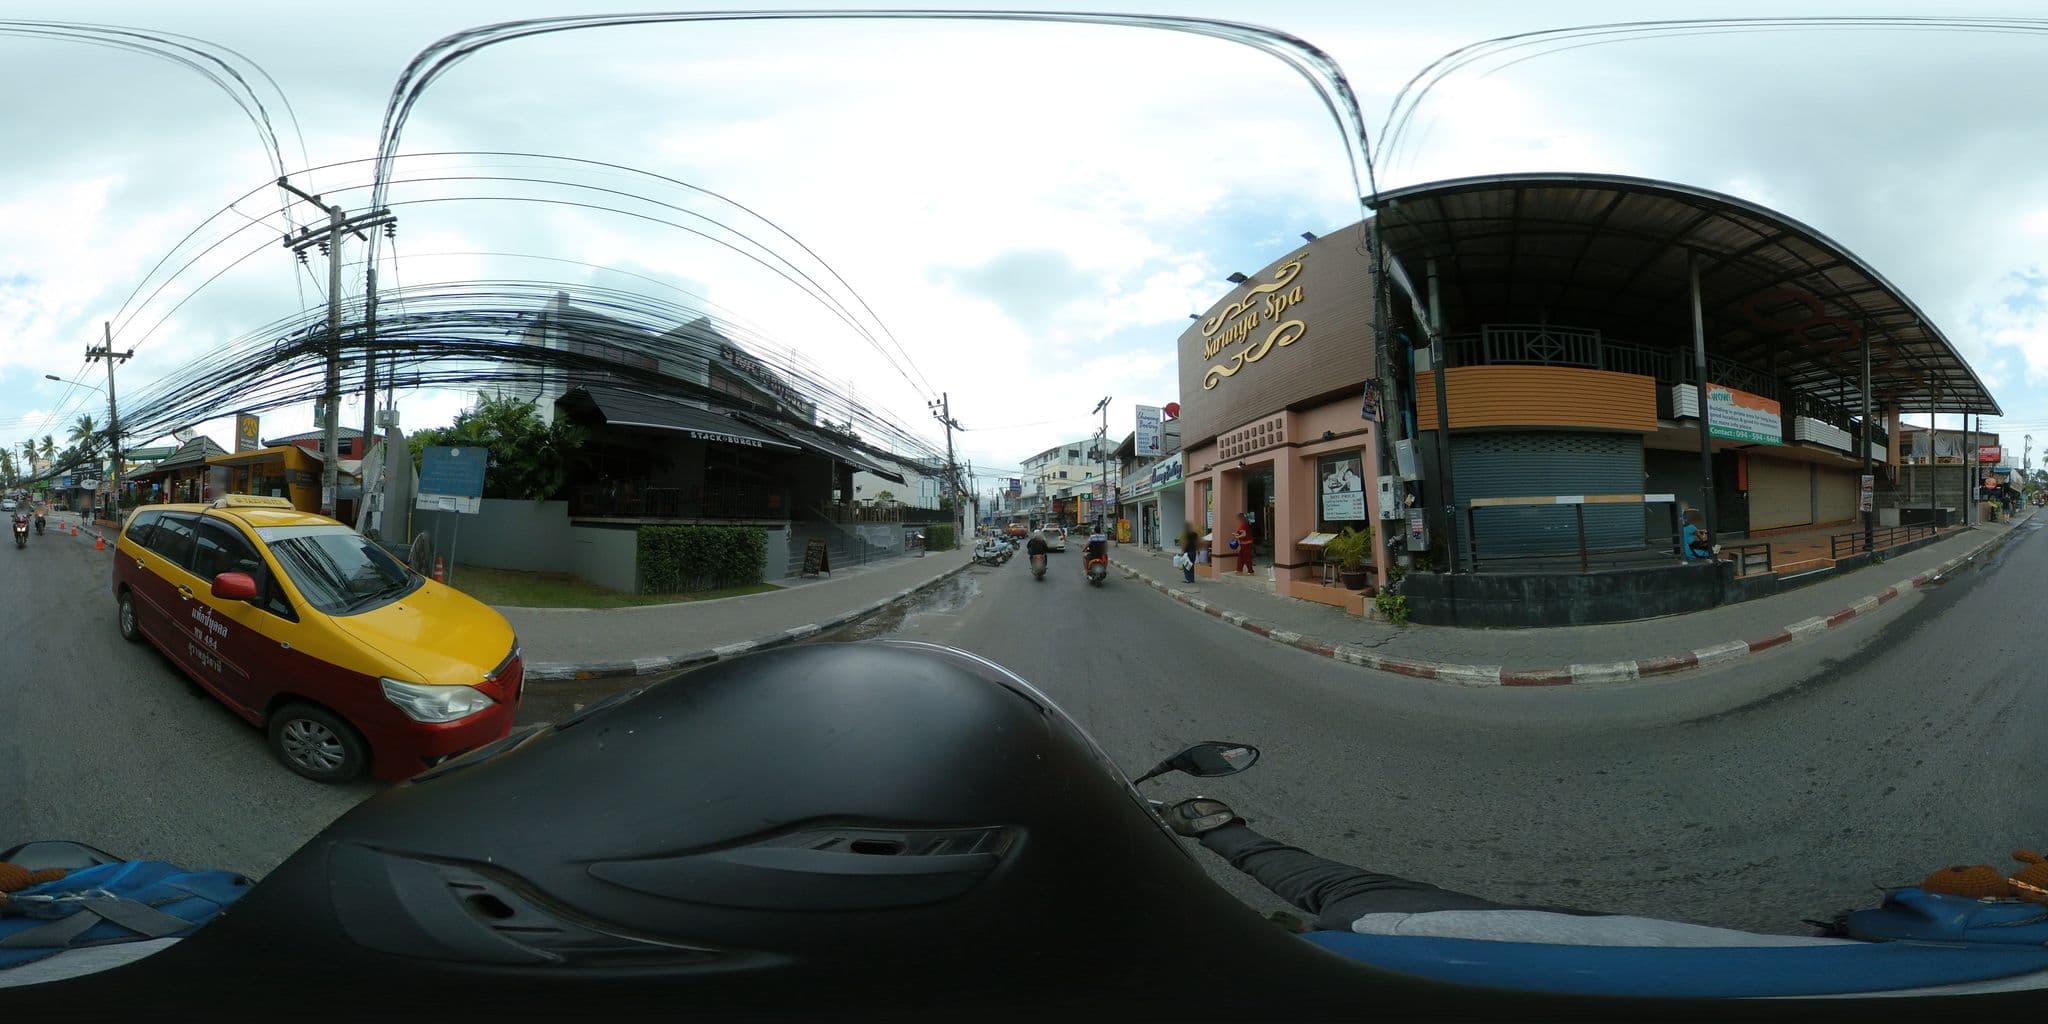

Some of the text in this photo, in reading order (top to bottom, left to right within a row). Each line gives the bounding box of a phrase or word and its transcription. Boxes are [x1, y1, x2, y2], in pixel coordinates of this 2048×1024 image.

[1204, 286, 1303, 361] Sarunya Spa
[690, 431, 763, 448] STACK BURGER
